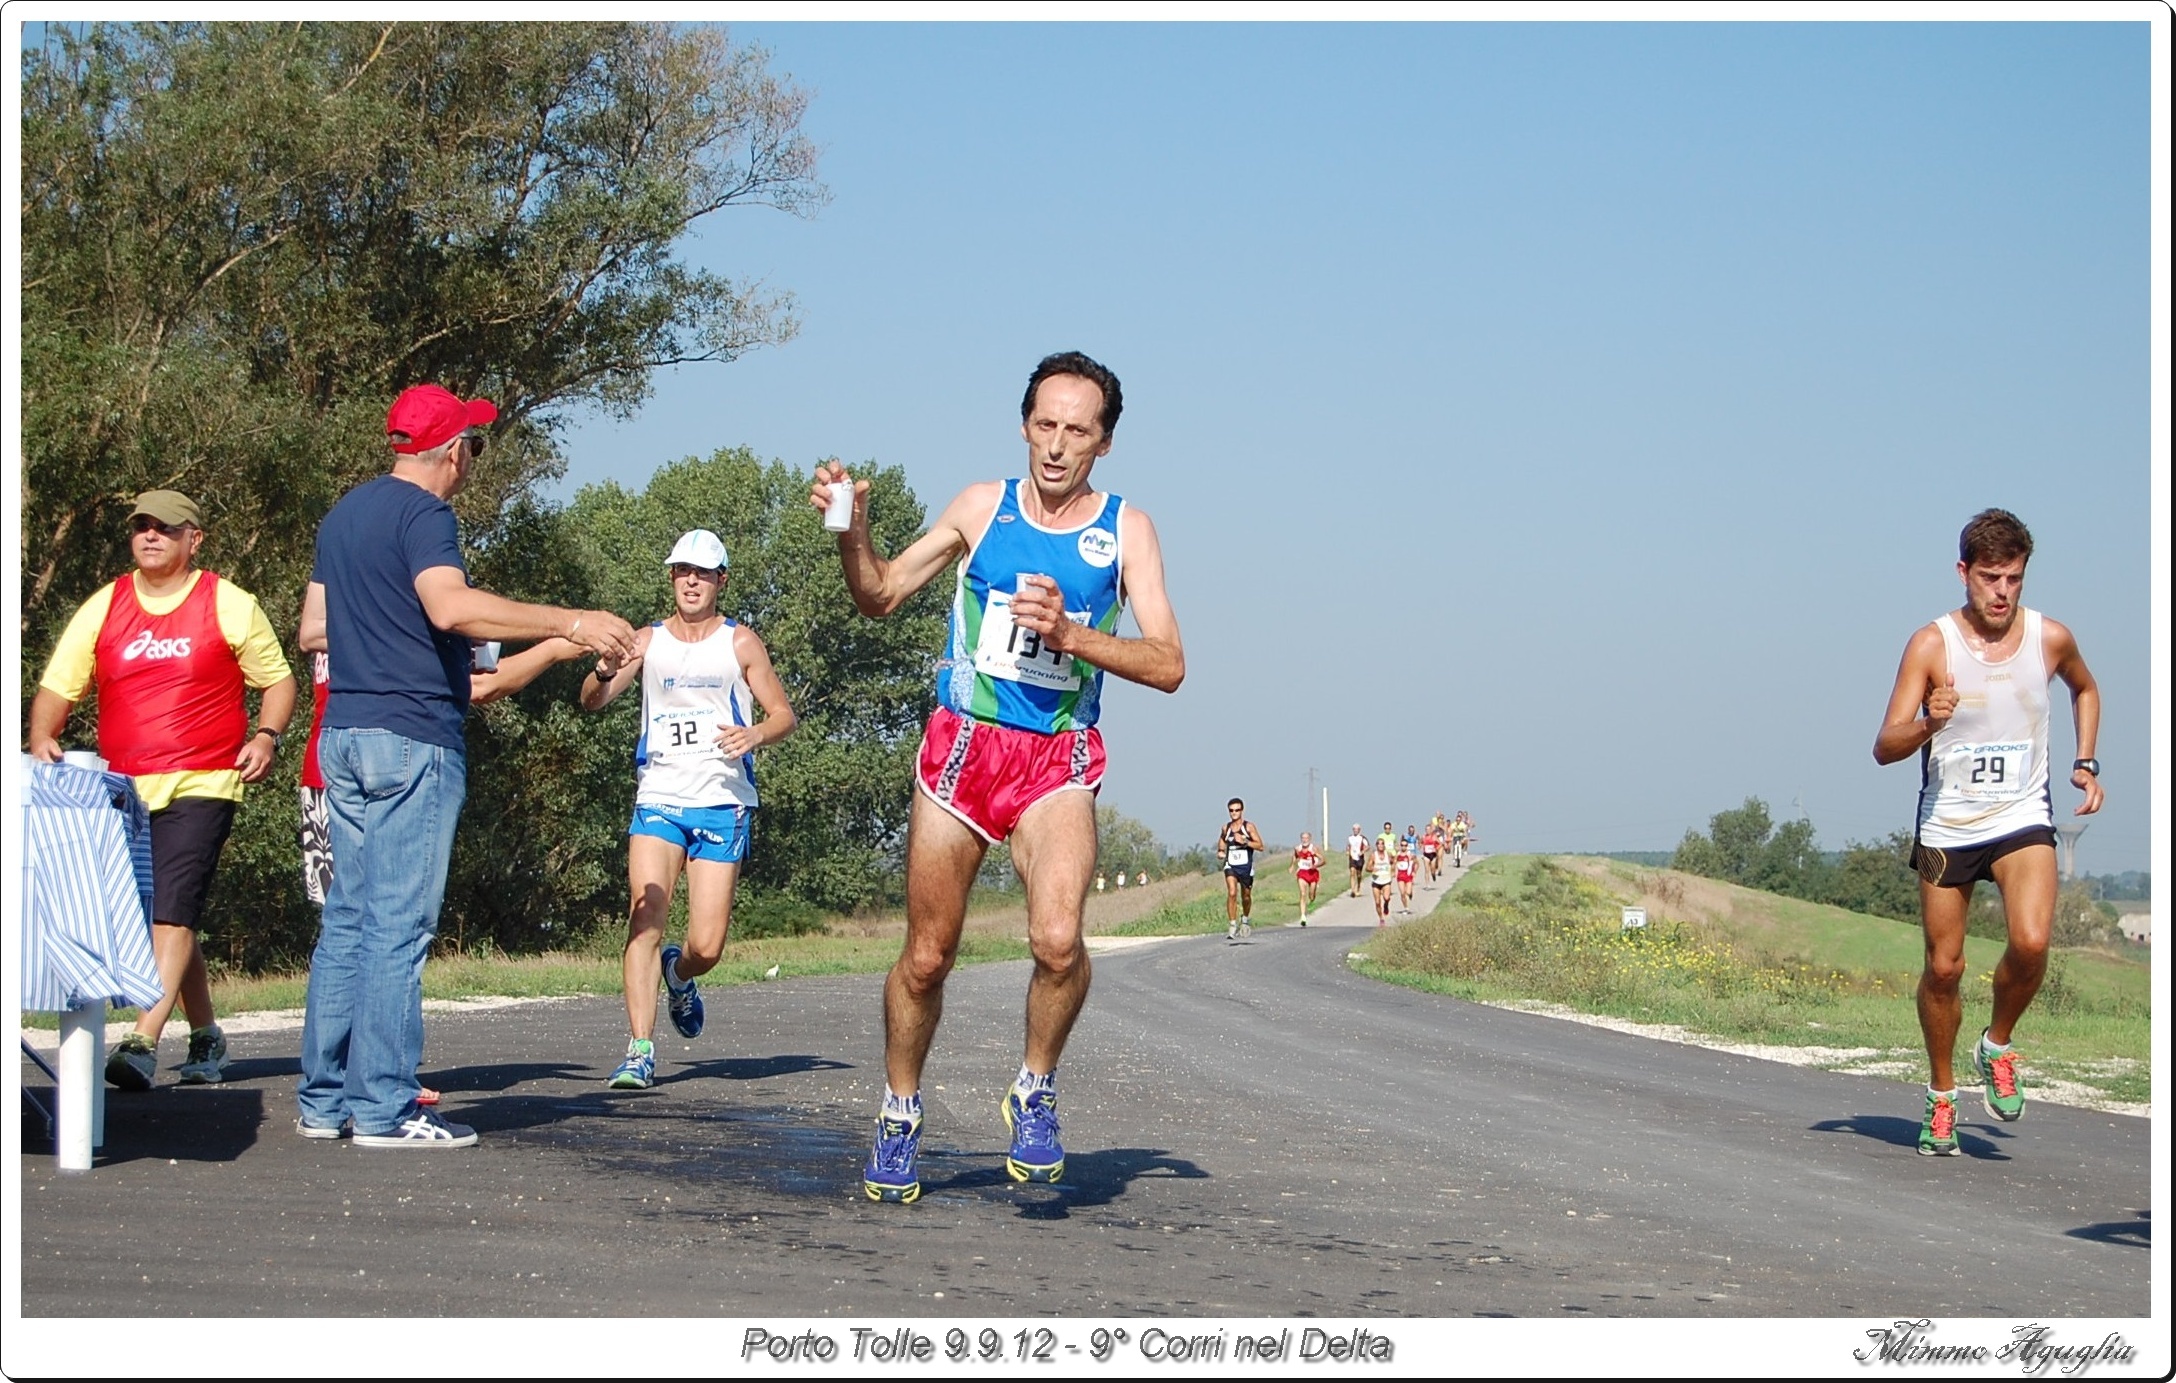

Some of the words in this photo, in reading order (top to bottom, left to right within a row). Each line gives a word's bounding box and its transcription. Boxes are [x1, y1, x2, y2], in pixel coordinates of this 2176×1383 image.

[670, 721, 698, 747] 32
[1973, 743, 2029, 754] BROOKS
[1971, 756, 2005, 784] 29
